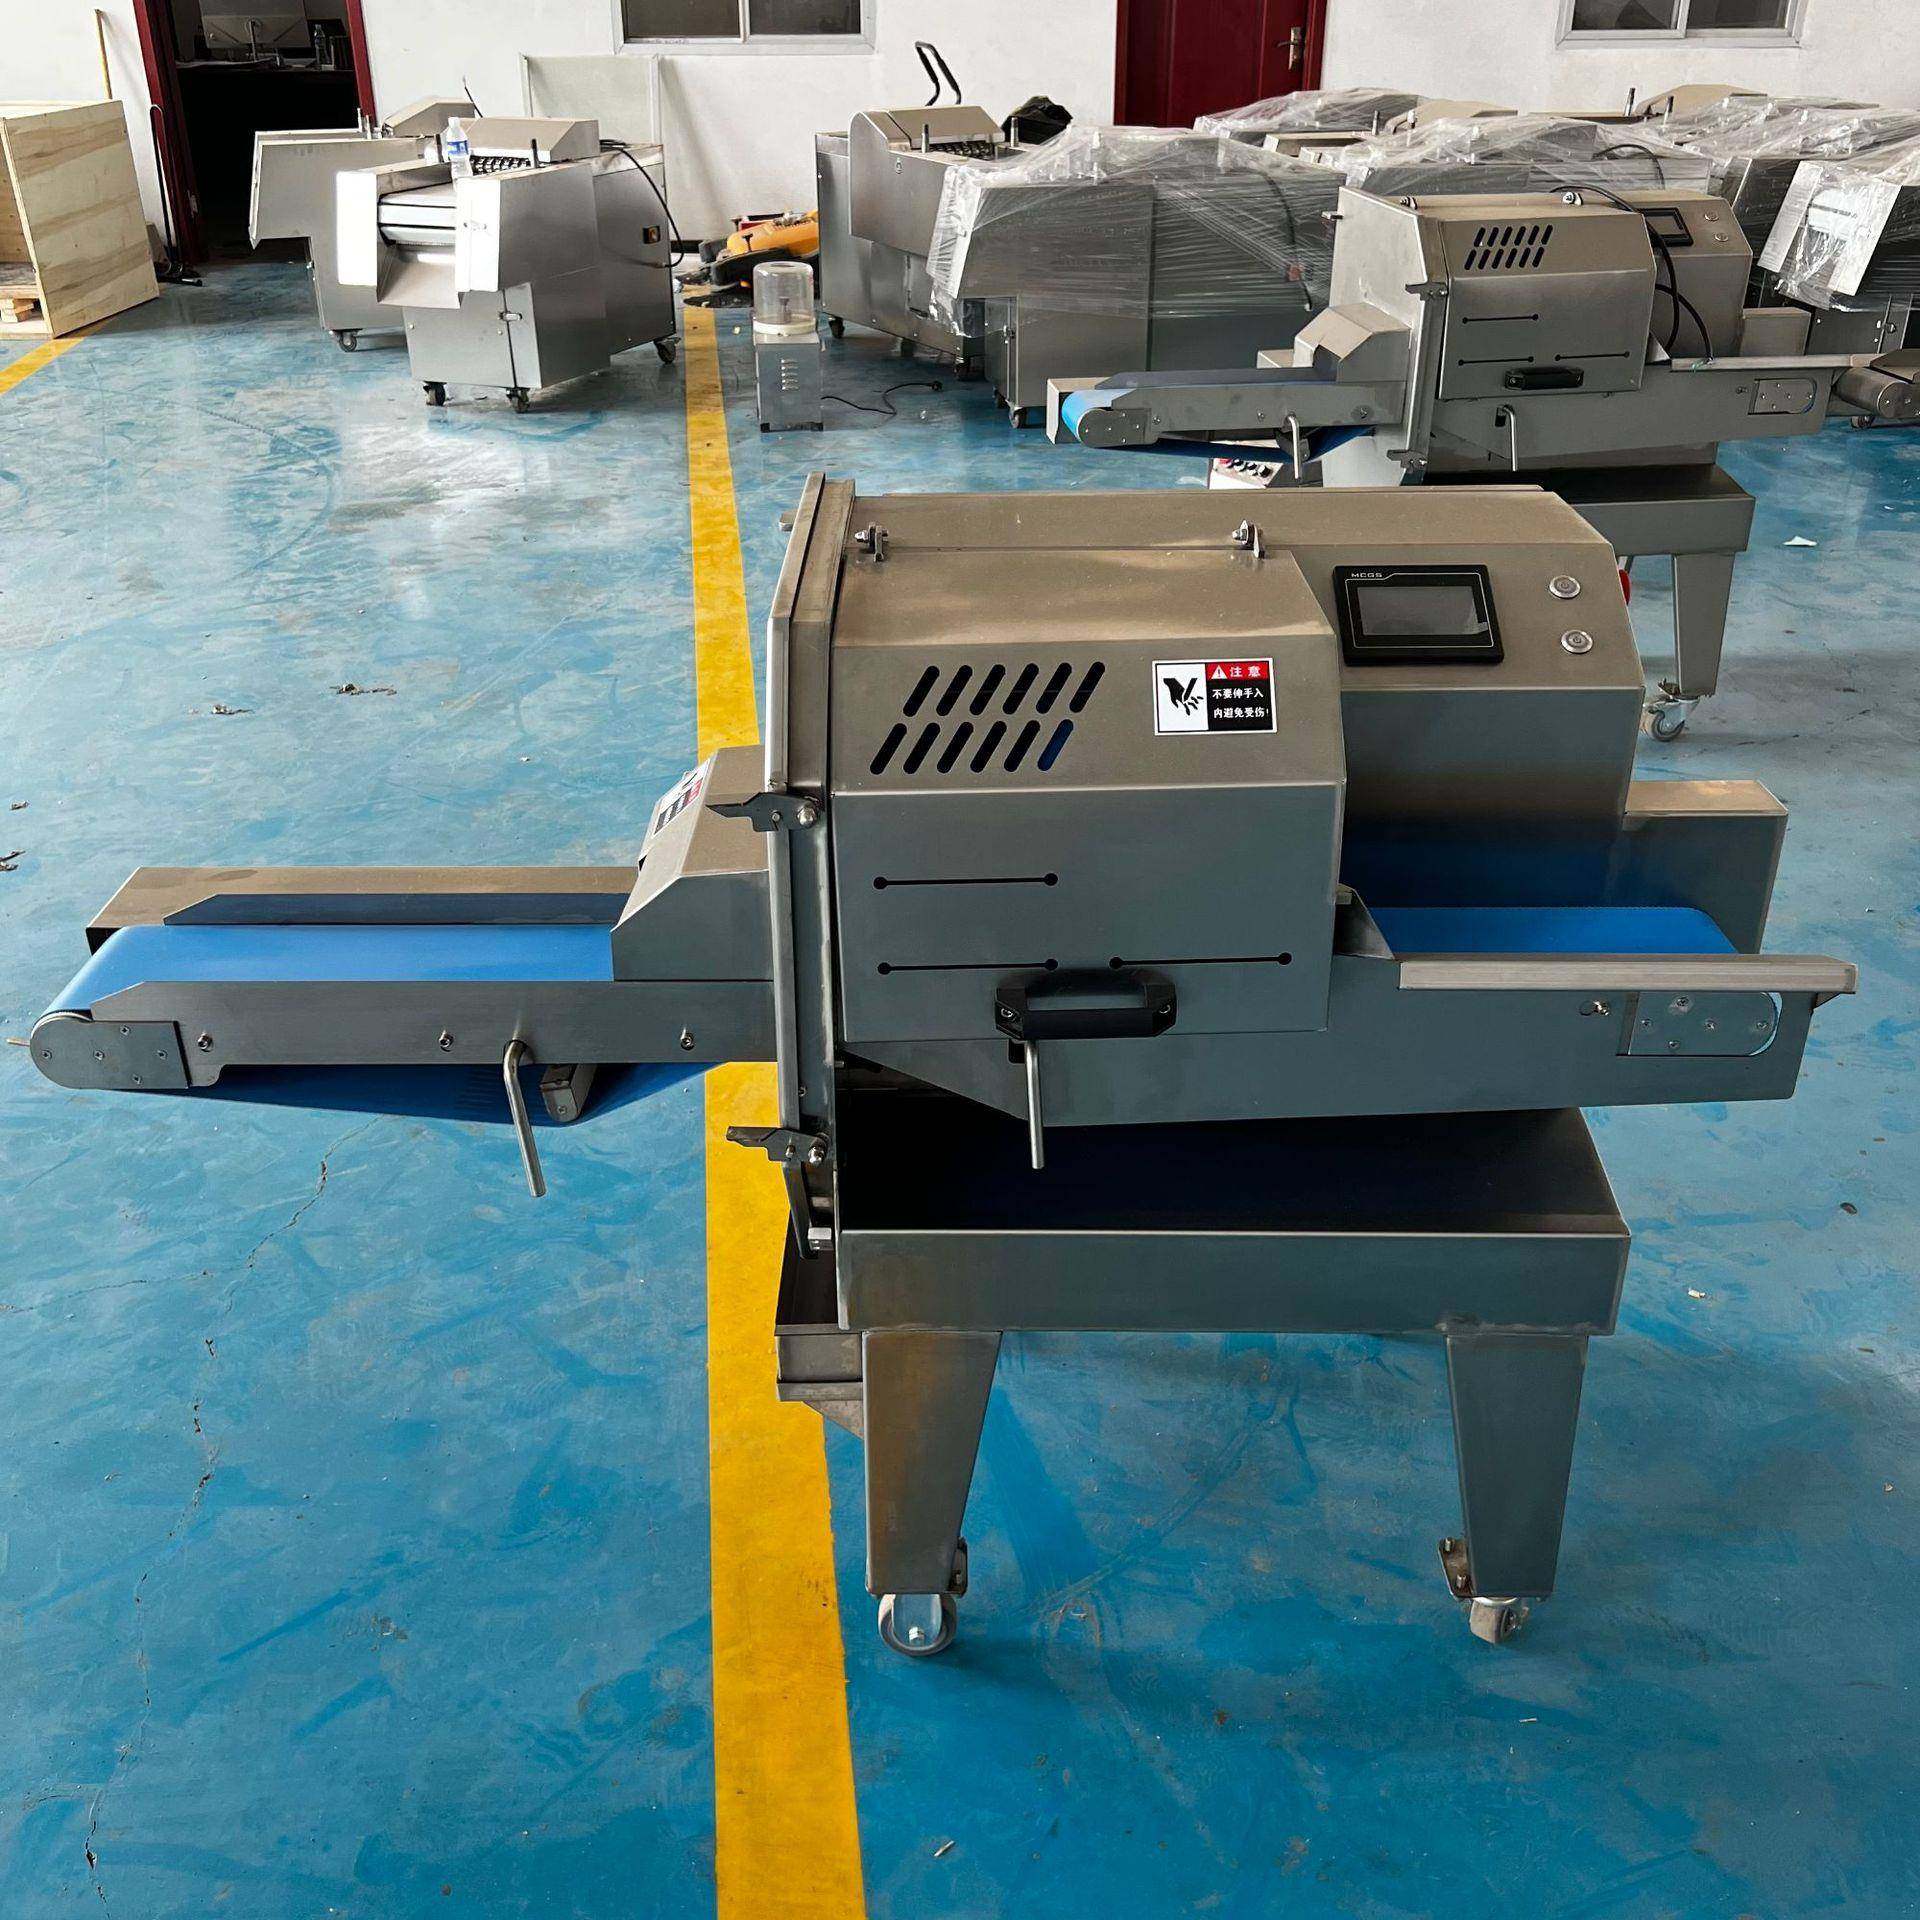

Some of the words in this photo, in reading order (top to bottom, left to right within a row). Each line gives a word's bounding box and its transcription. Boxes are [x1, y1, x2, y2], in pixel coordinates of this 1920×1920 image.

[1229, 666, 1261, 678] 注意
[1212, 687, 1264, 699] 不要伸手入
